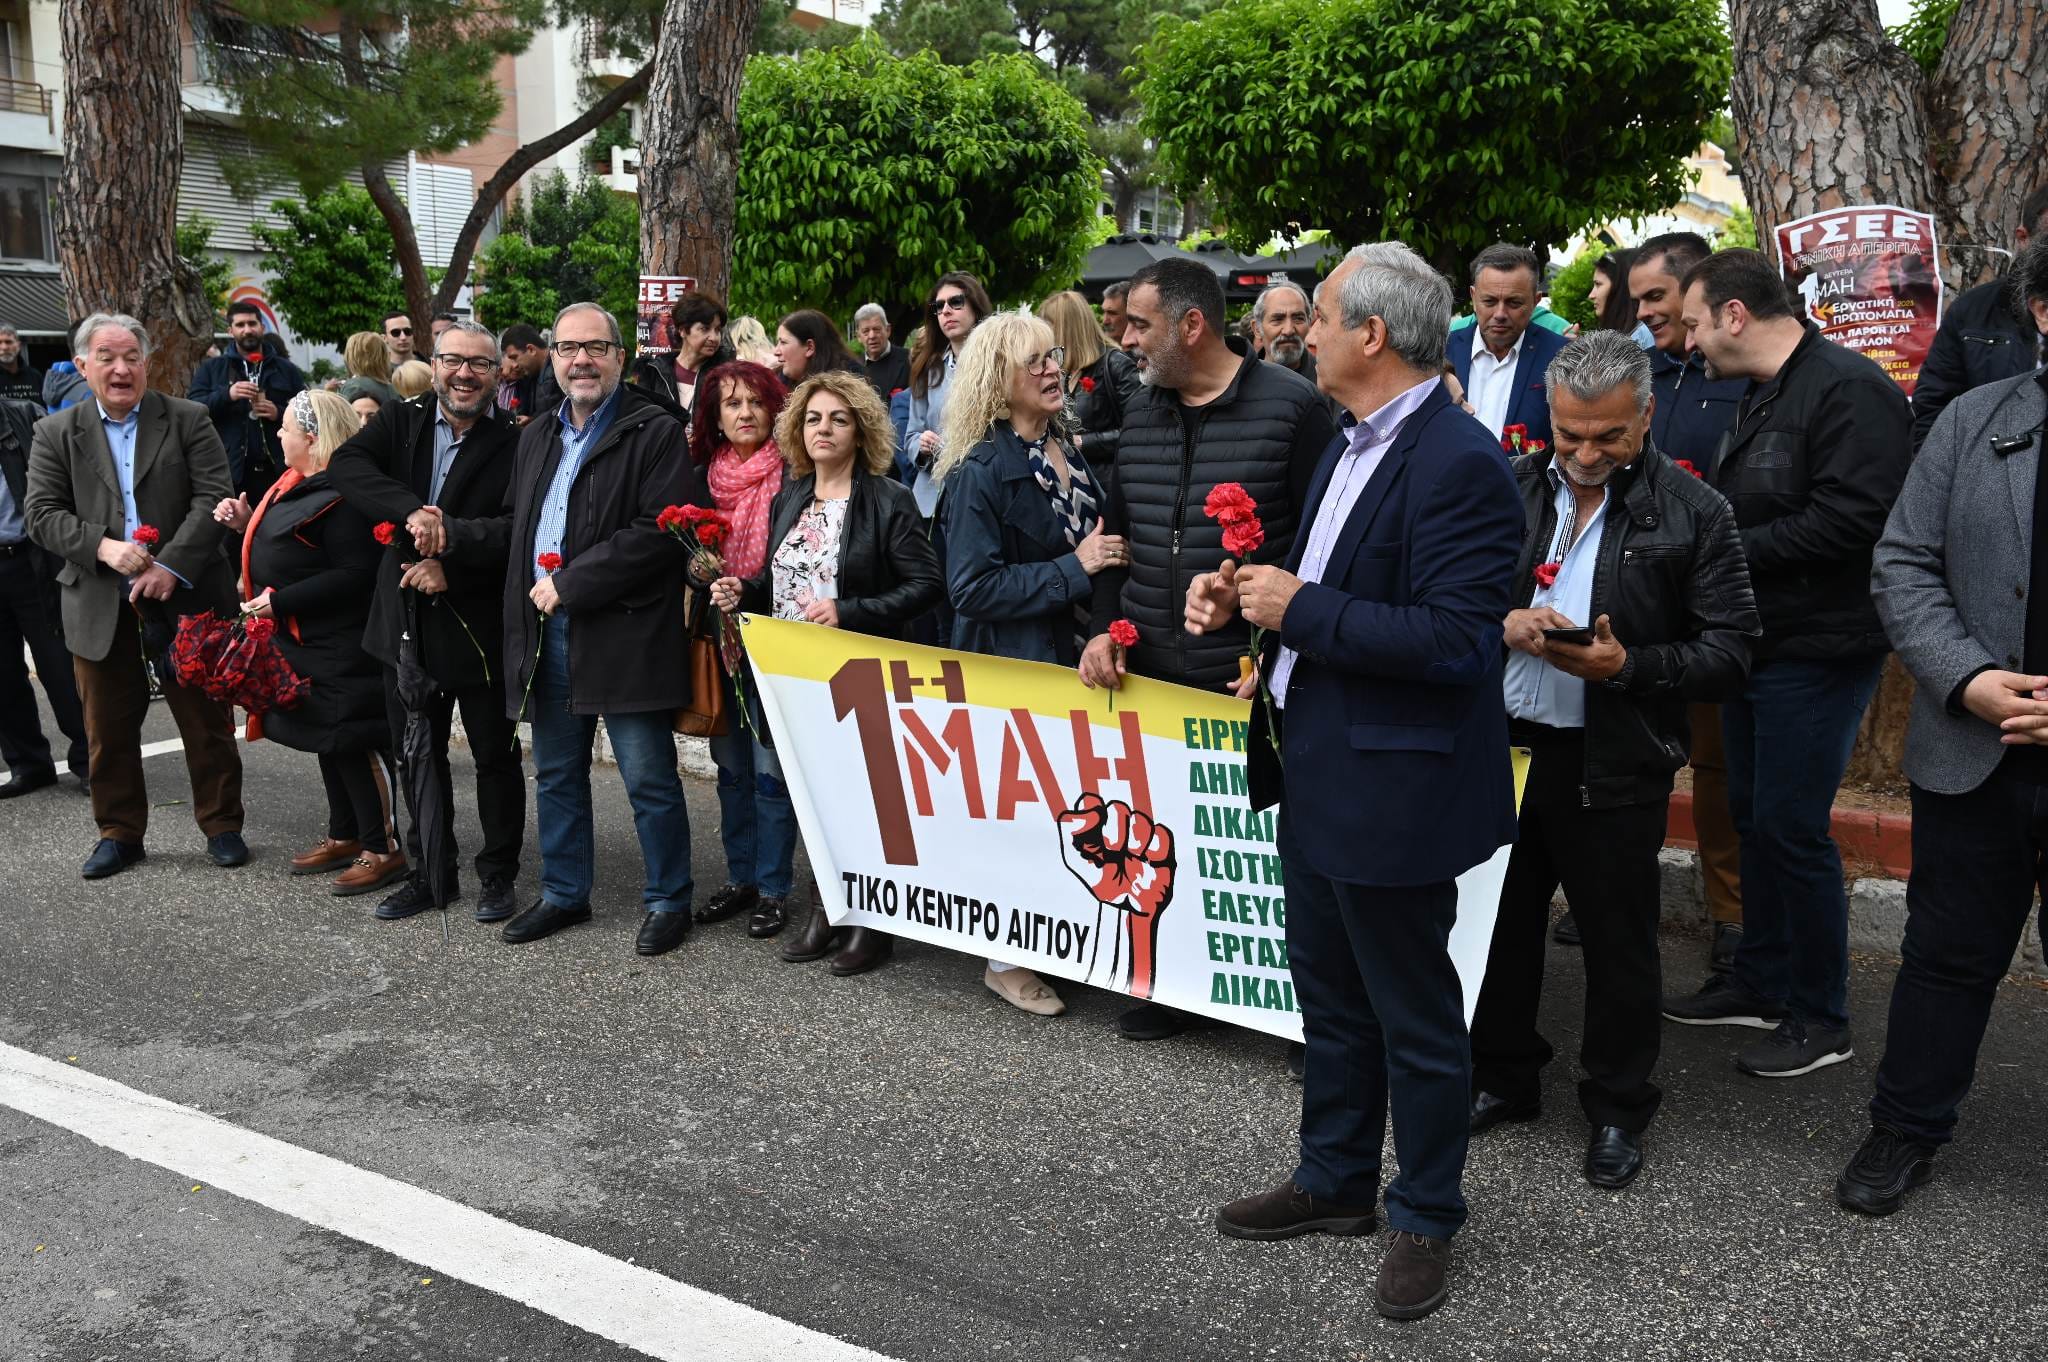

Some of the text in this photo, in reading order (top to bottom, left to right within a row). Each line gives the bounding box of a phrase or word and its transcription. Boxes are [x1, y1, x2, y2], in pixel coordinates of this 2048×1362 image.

[1789, 213, 1922, 255] ΓΣΕΕ
[1792, 241, 1921, 271] ΓΕΝΙΚΗ ΑΠΕΡΓΙΑ
[1815, 276, 1854, 298] ΜΑΗ
[1833, 309, 1915, 326] ΠΡΩΤΟΜΑΓΙΑ
[1847, 325, 1887, 338] ΠΑΡΟΝ
[1890, 325, 1910, 334] ΚΑΙ
[898, 708, 1156, 824] ΜΑΗ
[1194, 804, 1280, 843] ΔΙΚΑΙ
[842, 871, 1090, 964] ΤΙΚΟ ΚΕΝΤΡΟ ΑΙΓΙΟΥ
